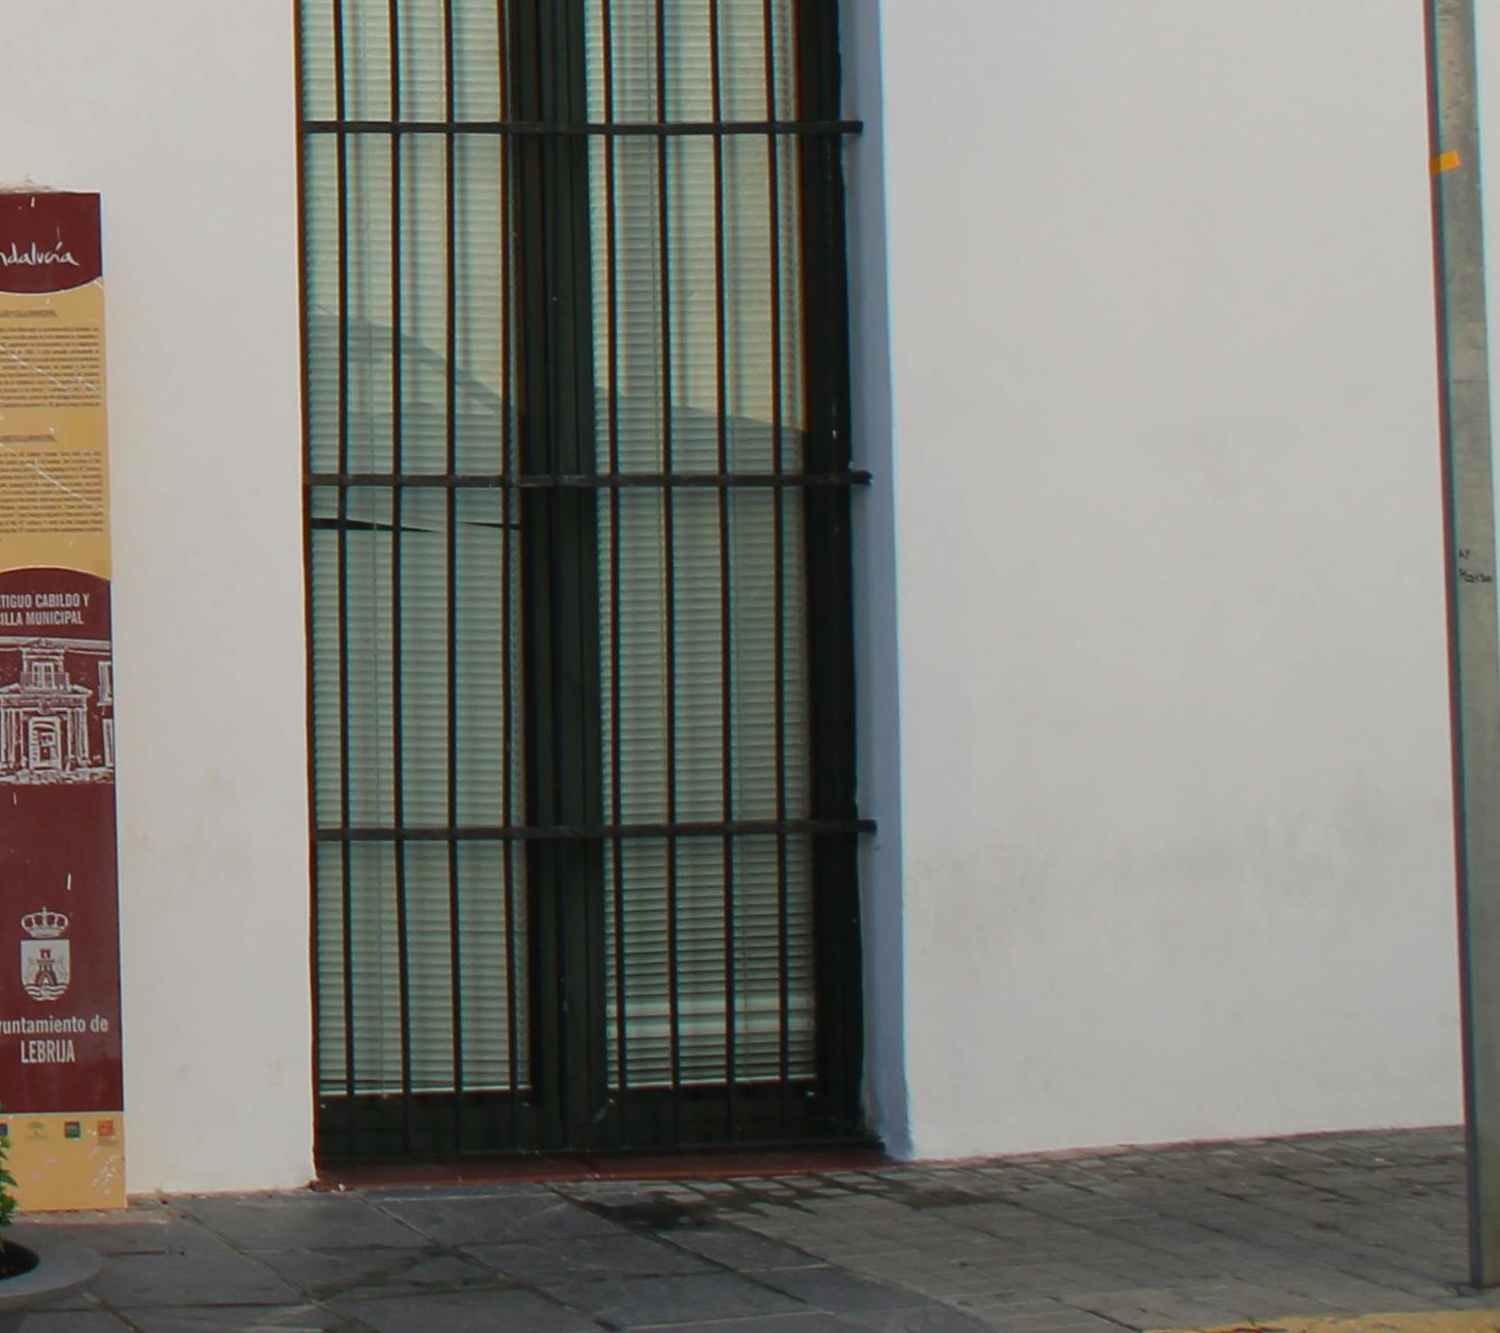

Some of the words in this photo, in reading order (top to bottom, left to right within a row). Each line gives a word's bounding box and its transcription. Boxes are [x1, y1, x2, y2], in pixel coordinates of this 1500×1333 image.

[35, 593, 80, 608] CABILDO
[82, 592, 90, 607] Y
[25, 610, 85, 626] MUNICIPAL
[89, 1014, 109, 1033] de
[20, 1039, 76, 1064] LEBRIJA
